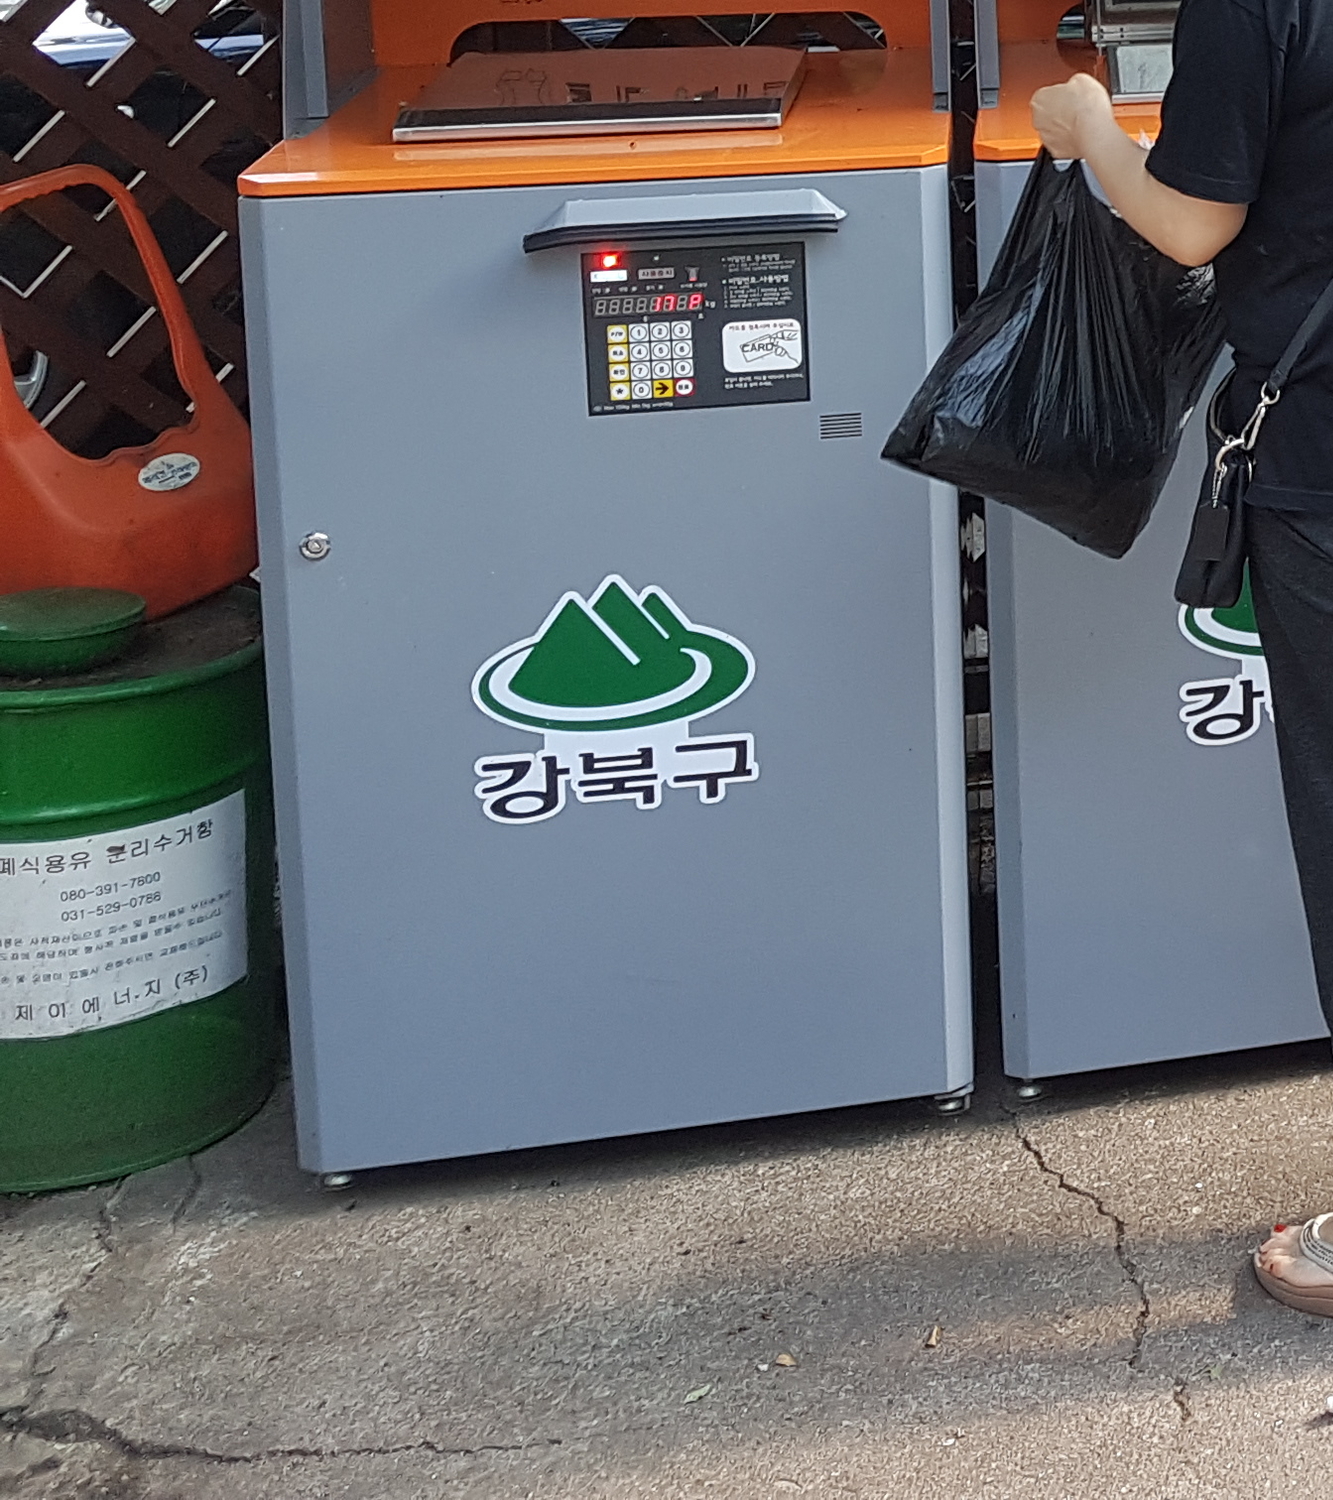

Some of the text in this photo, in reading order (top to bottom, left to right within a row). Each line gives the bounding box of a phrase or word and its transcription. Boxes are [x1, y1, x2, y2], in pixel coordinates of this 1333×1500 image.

[741, 341, 774, 354] CARD
[481, 740, 752, 820] 강북구
[175, 964, 209, 990] (주)
